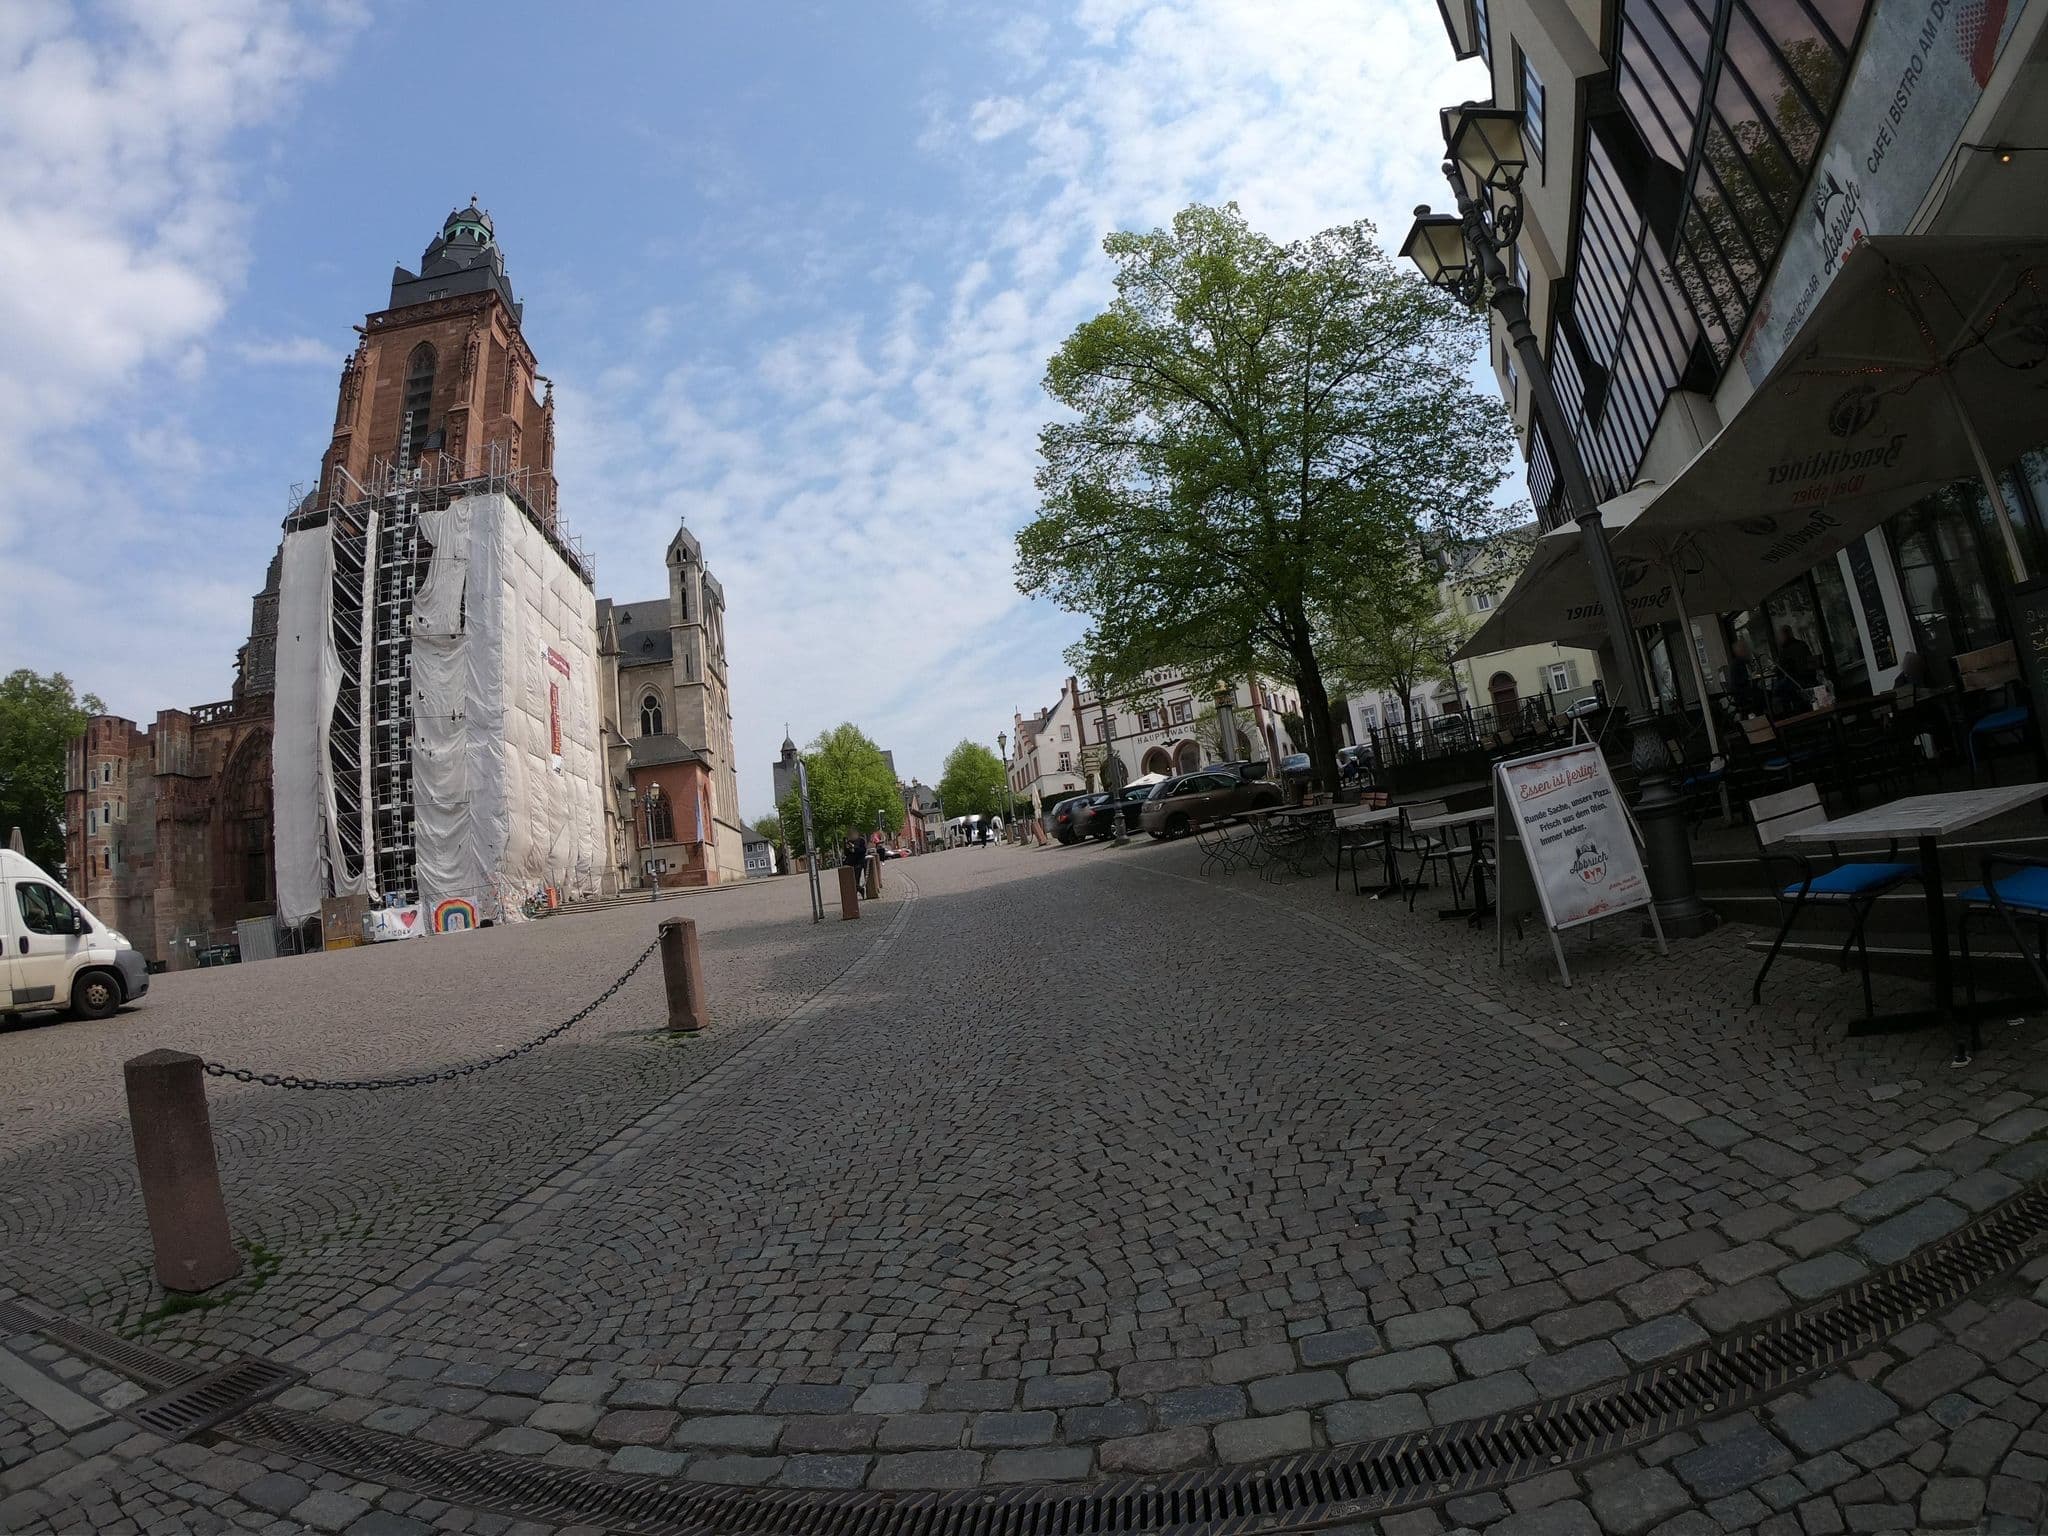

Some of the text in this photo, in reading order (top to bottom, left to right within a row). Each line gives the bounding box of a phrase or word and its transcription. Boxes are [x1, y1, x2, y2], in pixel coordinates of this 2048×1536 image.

[1867, 122, 1891, 174] CAFÉ
[1889, 55, 1923, 125] BISTRO
[1918, 18, 1938, 58] AM
[1822, 179, 1860, 275] Abbruch
[1137, 726, 1196, 744] HAUPT WACH
[1520, 762, 1597, 799] Essen ist fertig!
[1524, 788, 1611, 824] Runde Sache, unsere Pizza.
[1539, 803, 1607, 832] Frisch aus dem Ofen.
[1540, 824, 1587, 845] Immer lecker.
[1570, 851, 1608, 874] Abbruch
